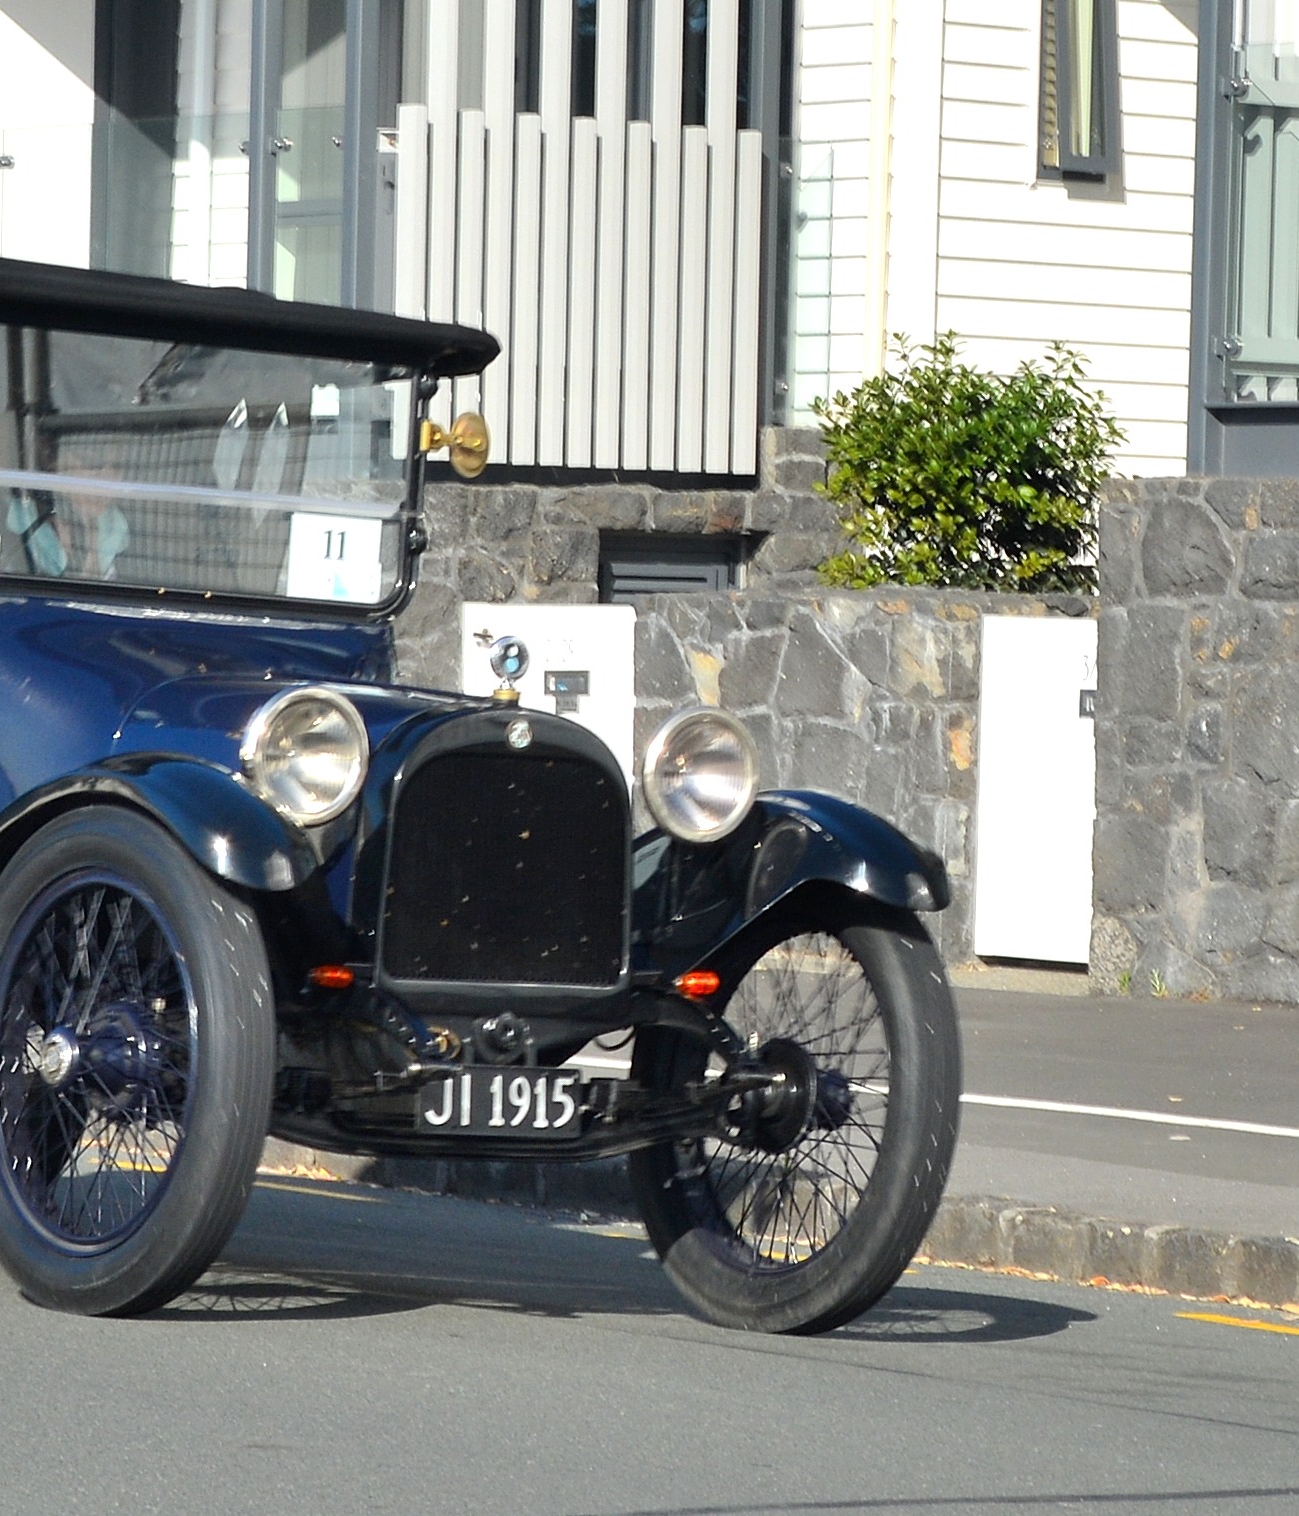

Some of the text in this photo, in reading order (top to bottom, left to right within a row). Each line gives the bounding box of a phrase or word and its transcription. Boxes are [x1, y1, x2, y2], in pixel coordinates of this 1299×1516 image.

[323, 530, 347, 561] 11
[424, 1074, 576, 1129] JI 1915
